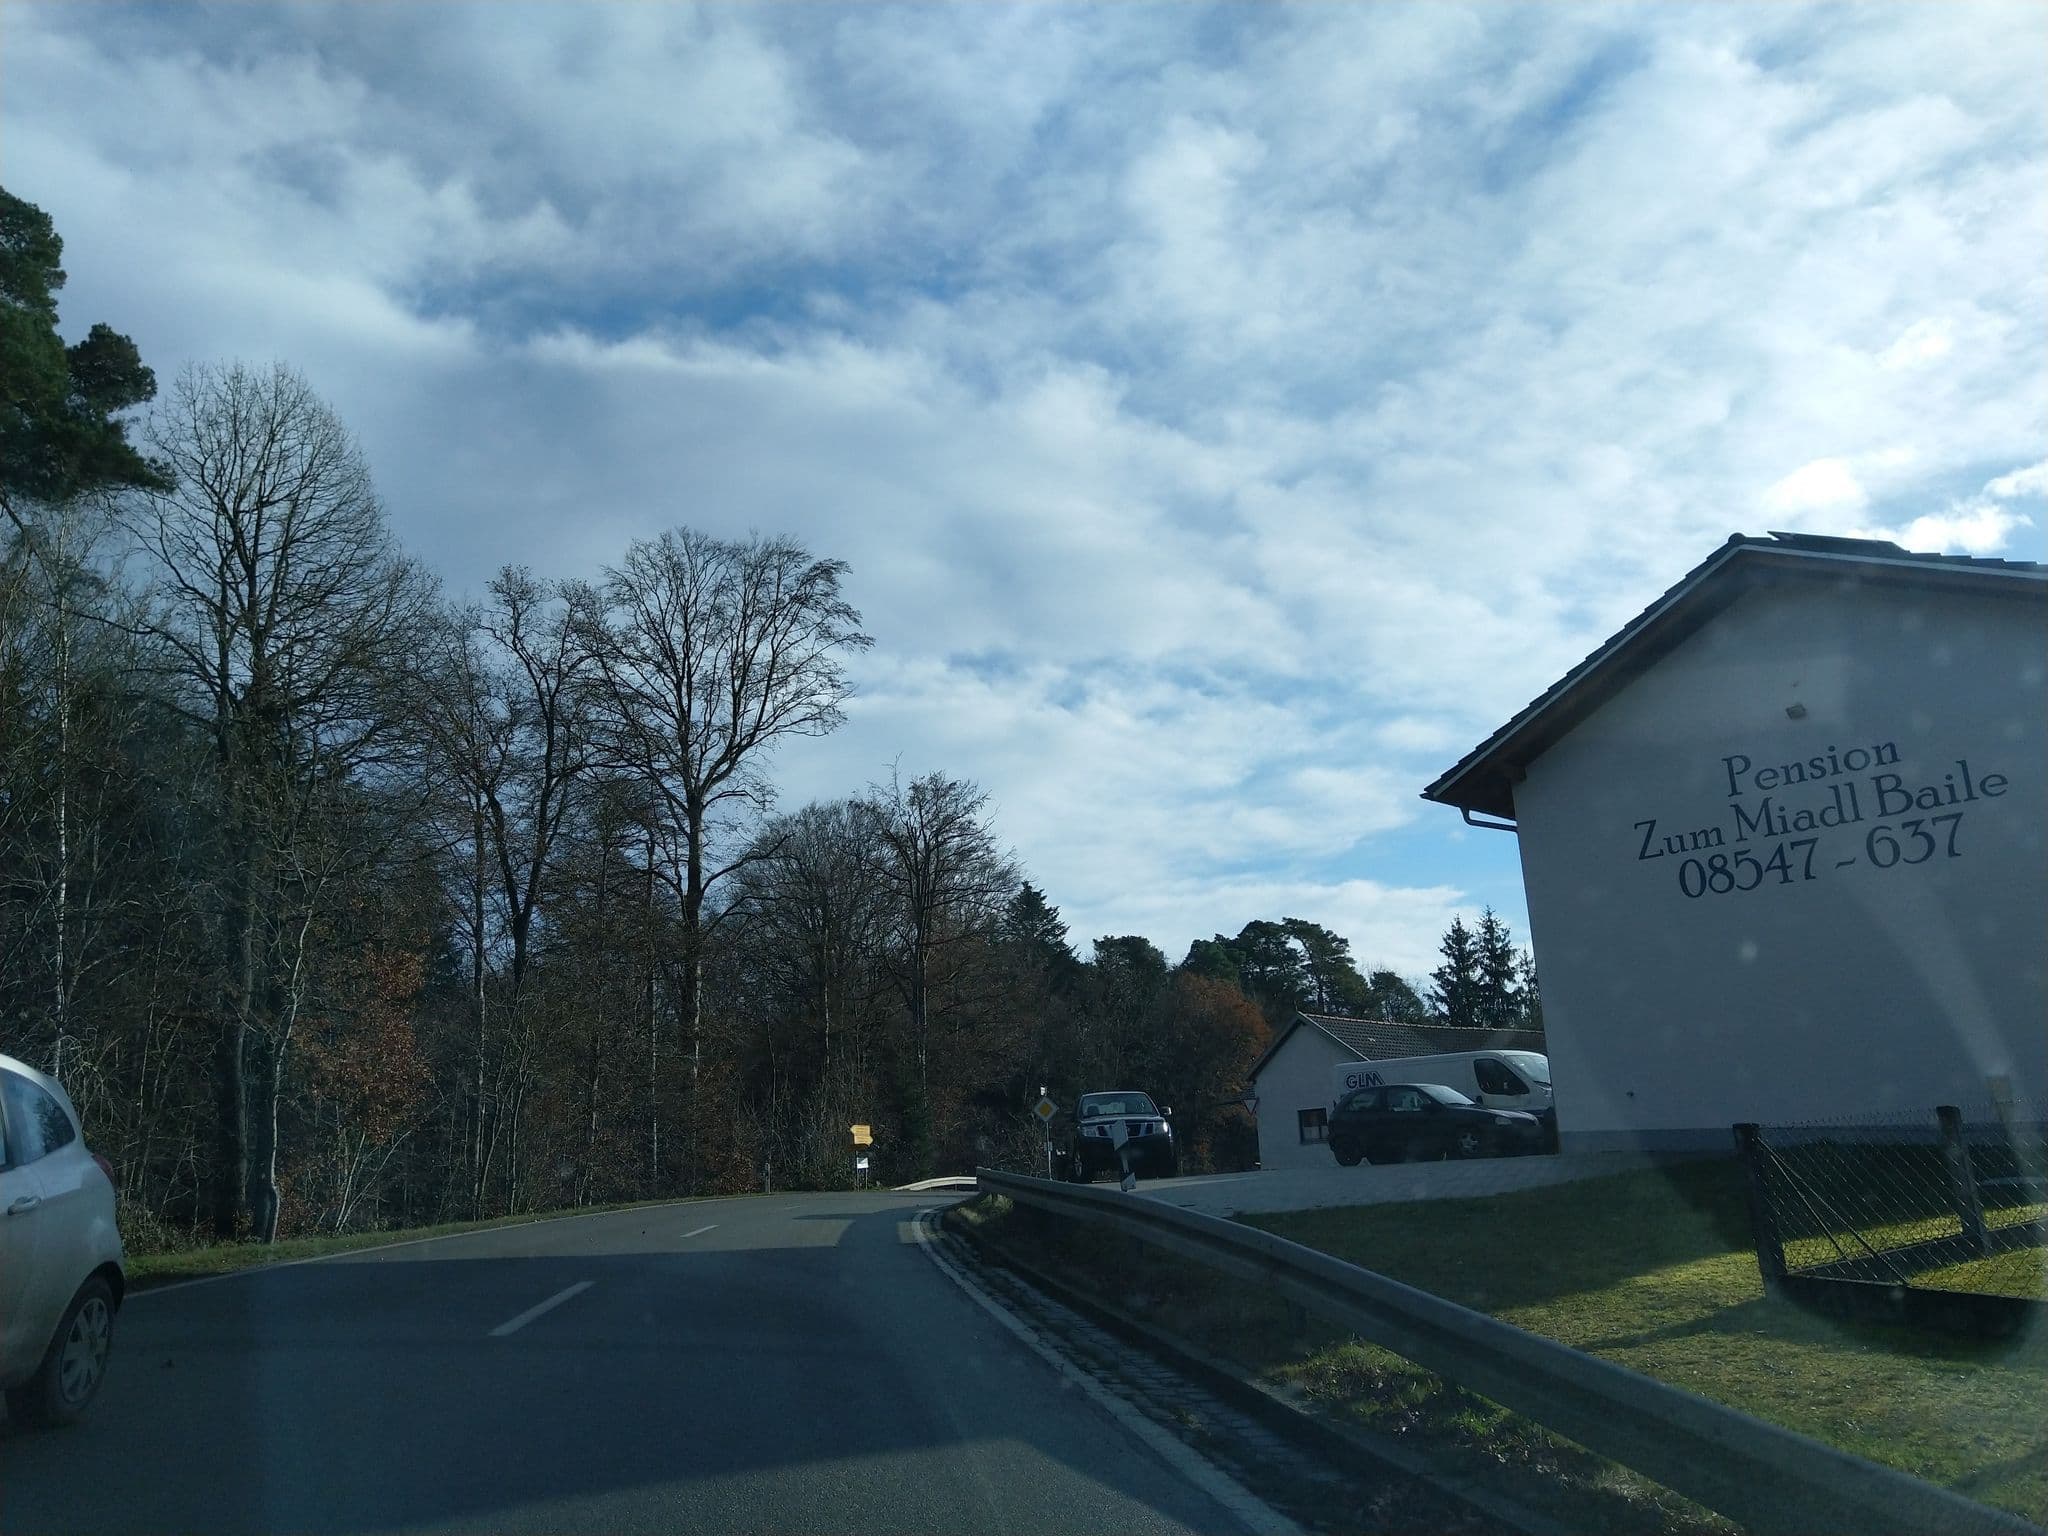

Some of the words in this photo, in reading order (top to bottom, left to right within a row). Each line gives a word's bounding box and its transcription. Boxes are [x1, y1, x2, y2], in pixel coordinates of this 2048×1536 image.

[1721, 741, 1902, 797] Pension
[1634, 819, 1726, 860] Zum
[1729, 781, 1864, 843] Miadl
[1870, 759, 2009, 818] Baile
[1678, 837, 1820, 899] 08547
[1865, 812, 1965, 869] 637
[1345, 1071, 1386, 1090] GLM
